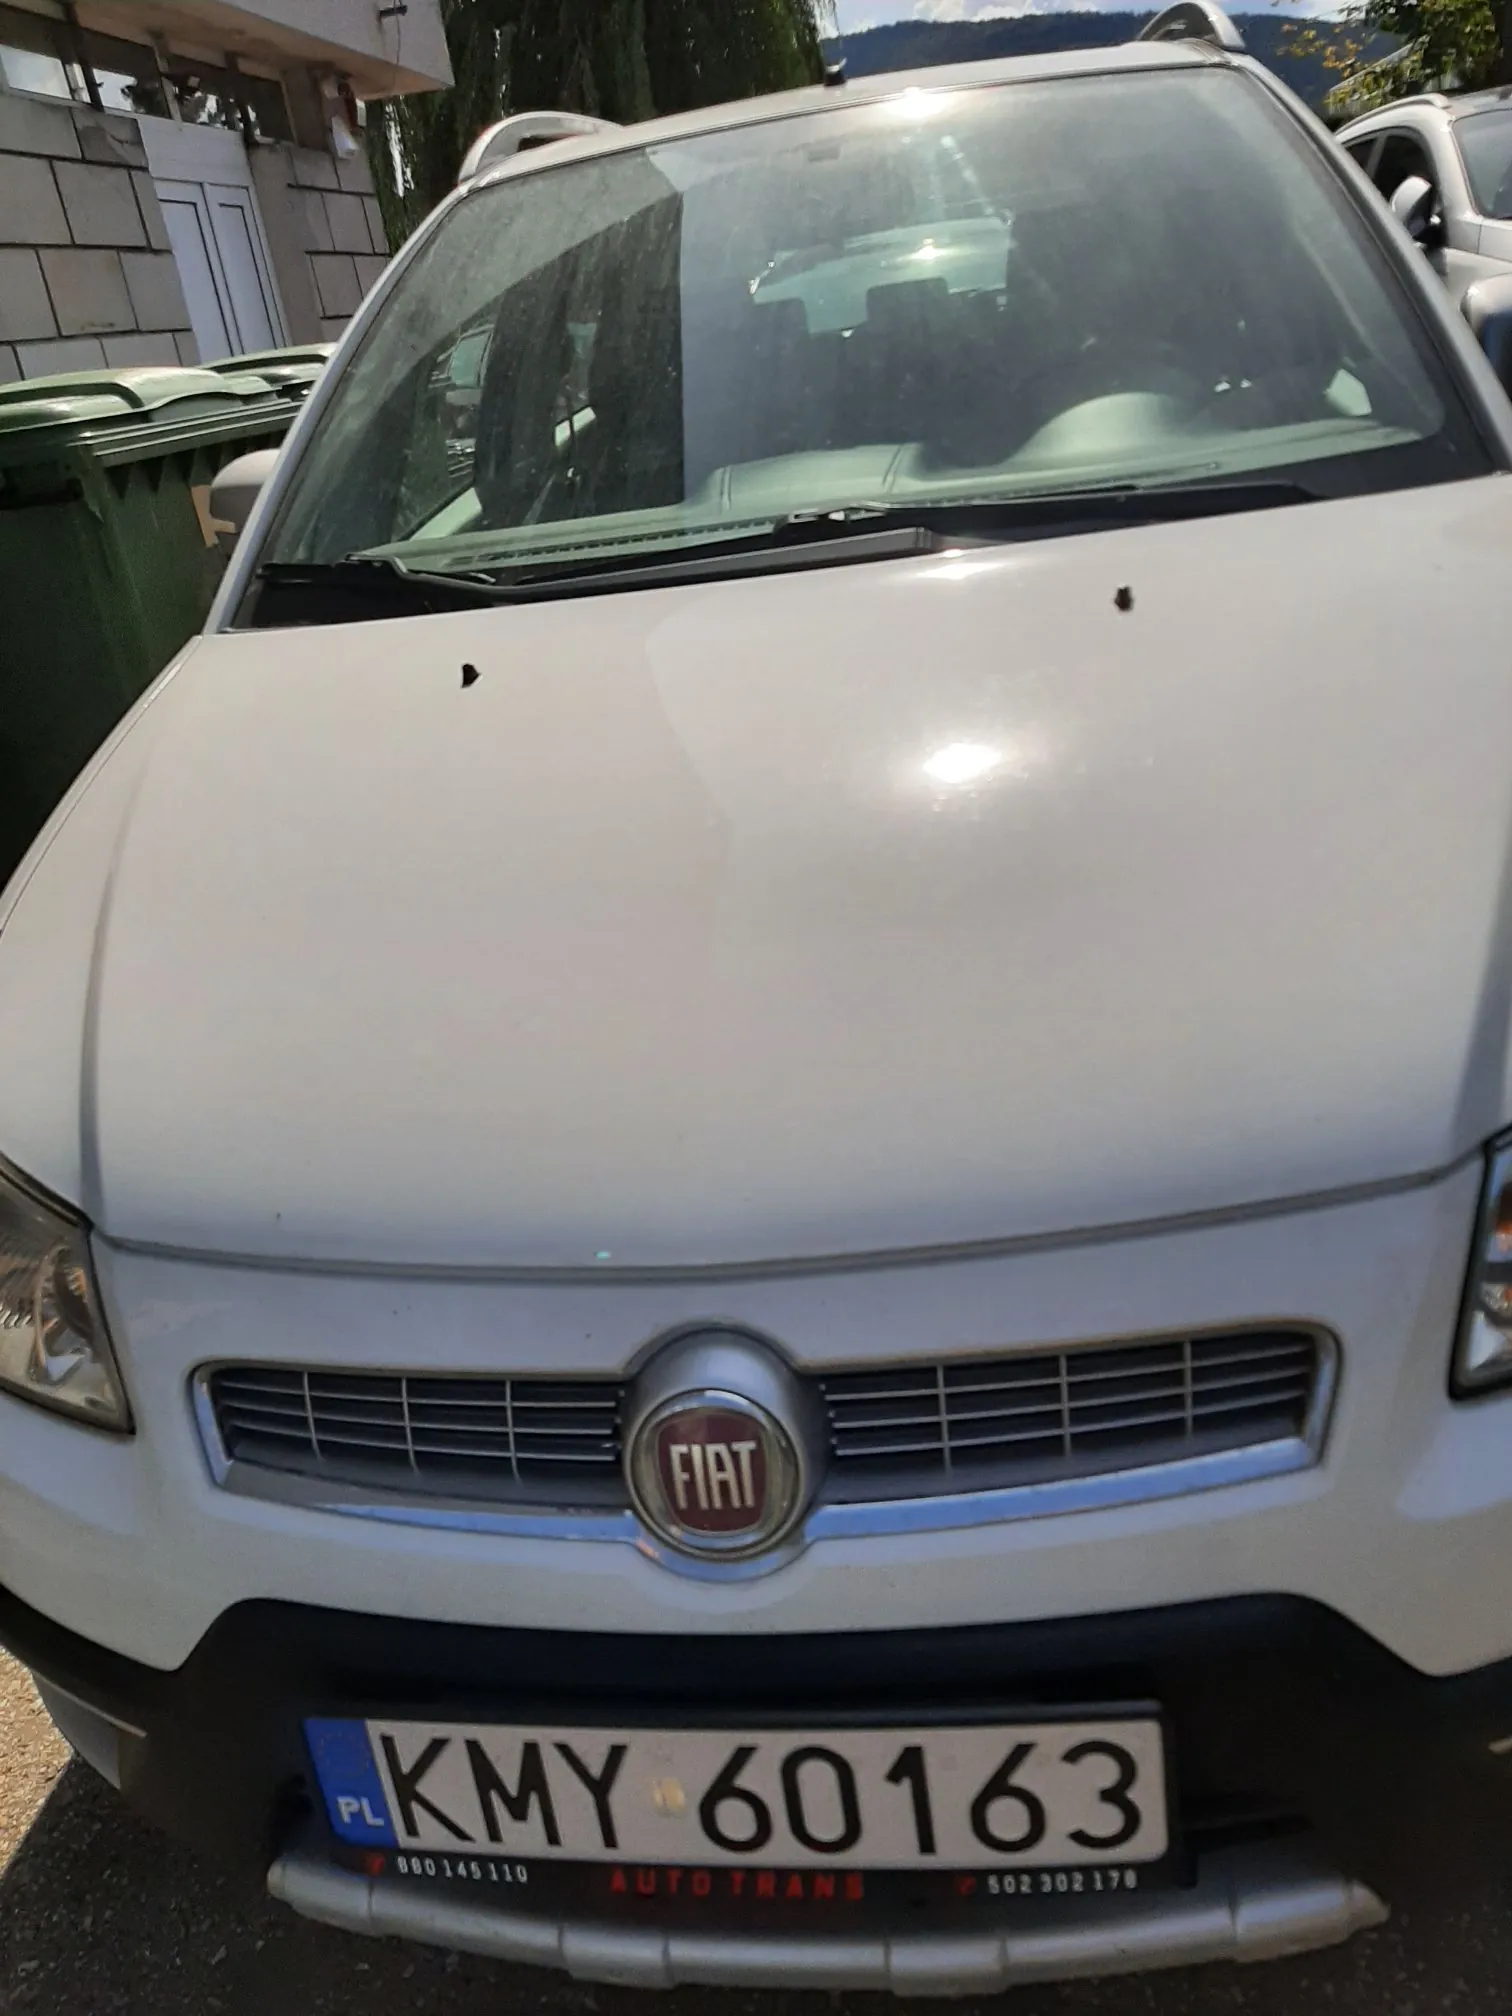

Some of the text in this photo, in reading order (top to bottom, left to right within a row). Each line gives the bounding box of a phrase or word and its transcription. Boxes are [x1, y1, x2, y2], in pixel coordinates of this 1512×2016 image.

[669, 1439, 757, 1510] FIAT
[337, 1794, 386, 1828] PL
[380, 1733, 1141, 1856] KMY 60163
[487, 1861, 528, 1884] 110
[609, 1868, 711, 1897] AUTO
